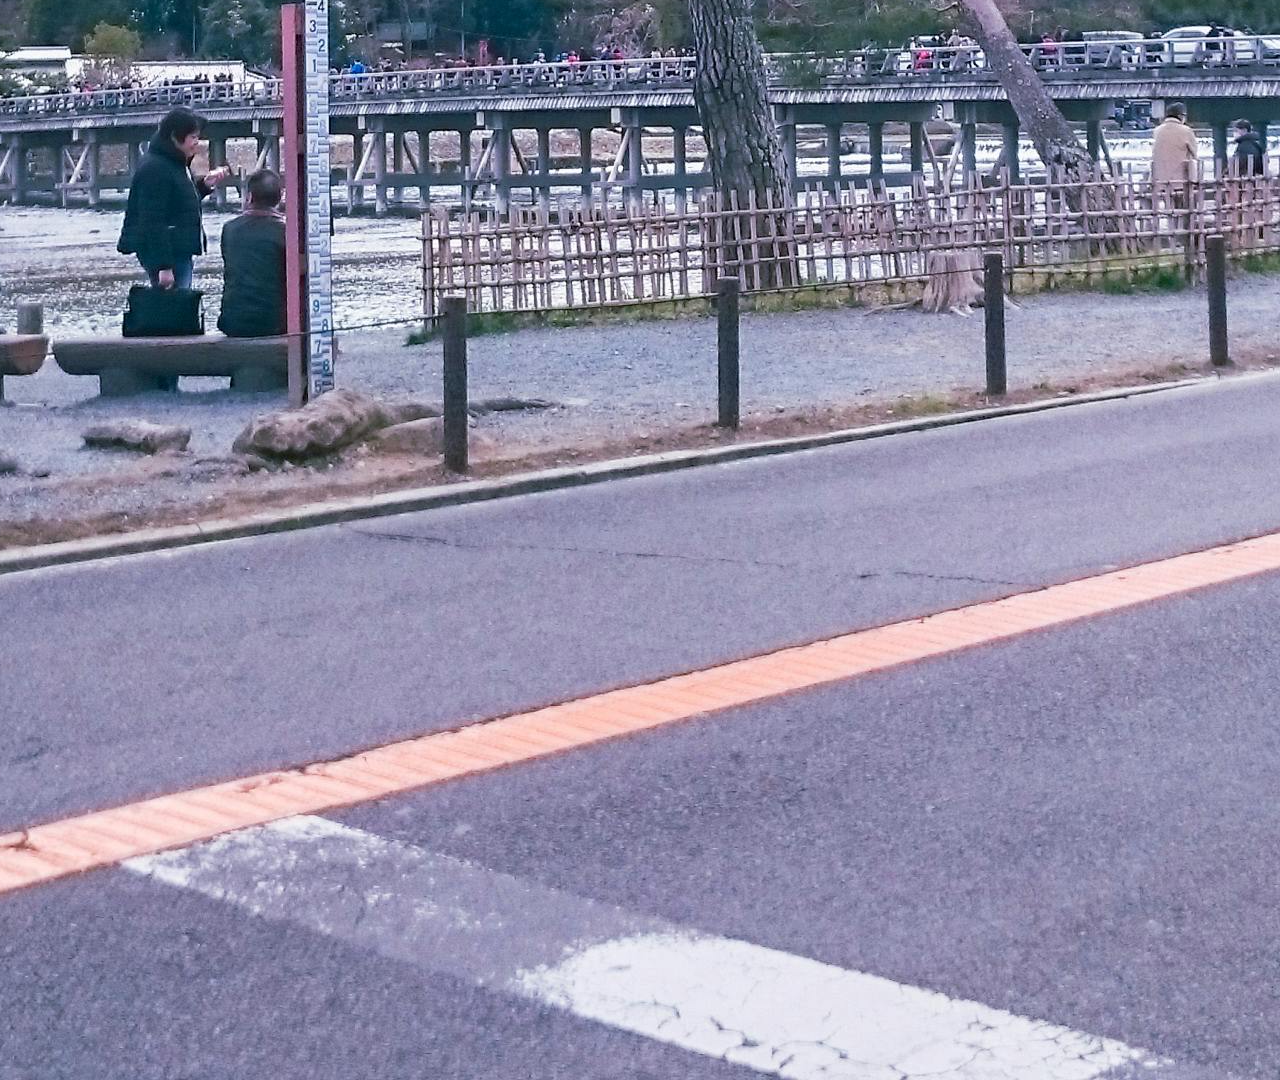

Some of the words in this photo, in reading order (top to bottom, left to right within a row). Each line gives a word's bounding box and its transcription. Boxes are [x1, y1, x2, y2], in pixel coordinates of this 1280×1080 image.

[317, 0, 325, 12] 4
[309, 19, 317, 32] 3
[318, 39, 326, 52] 2
[312, 59, 317, 72] 1
[320, 200, 328, 214] 4
[312, 299, 320, 313] 9
[321, 319, 329, 332] 8
[314, 339, 321, 352] 7
[314, 380, 321, 393] 5
